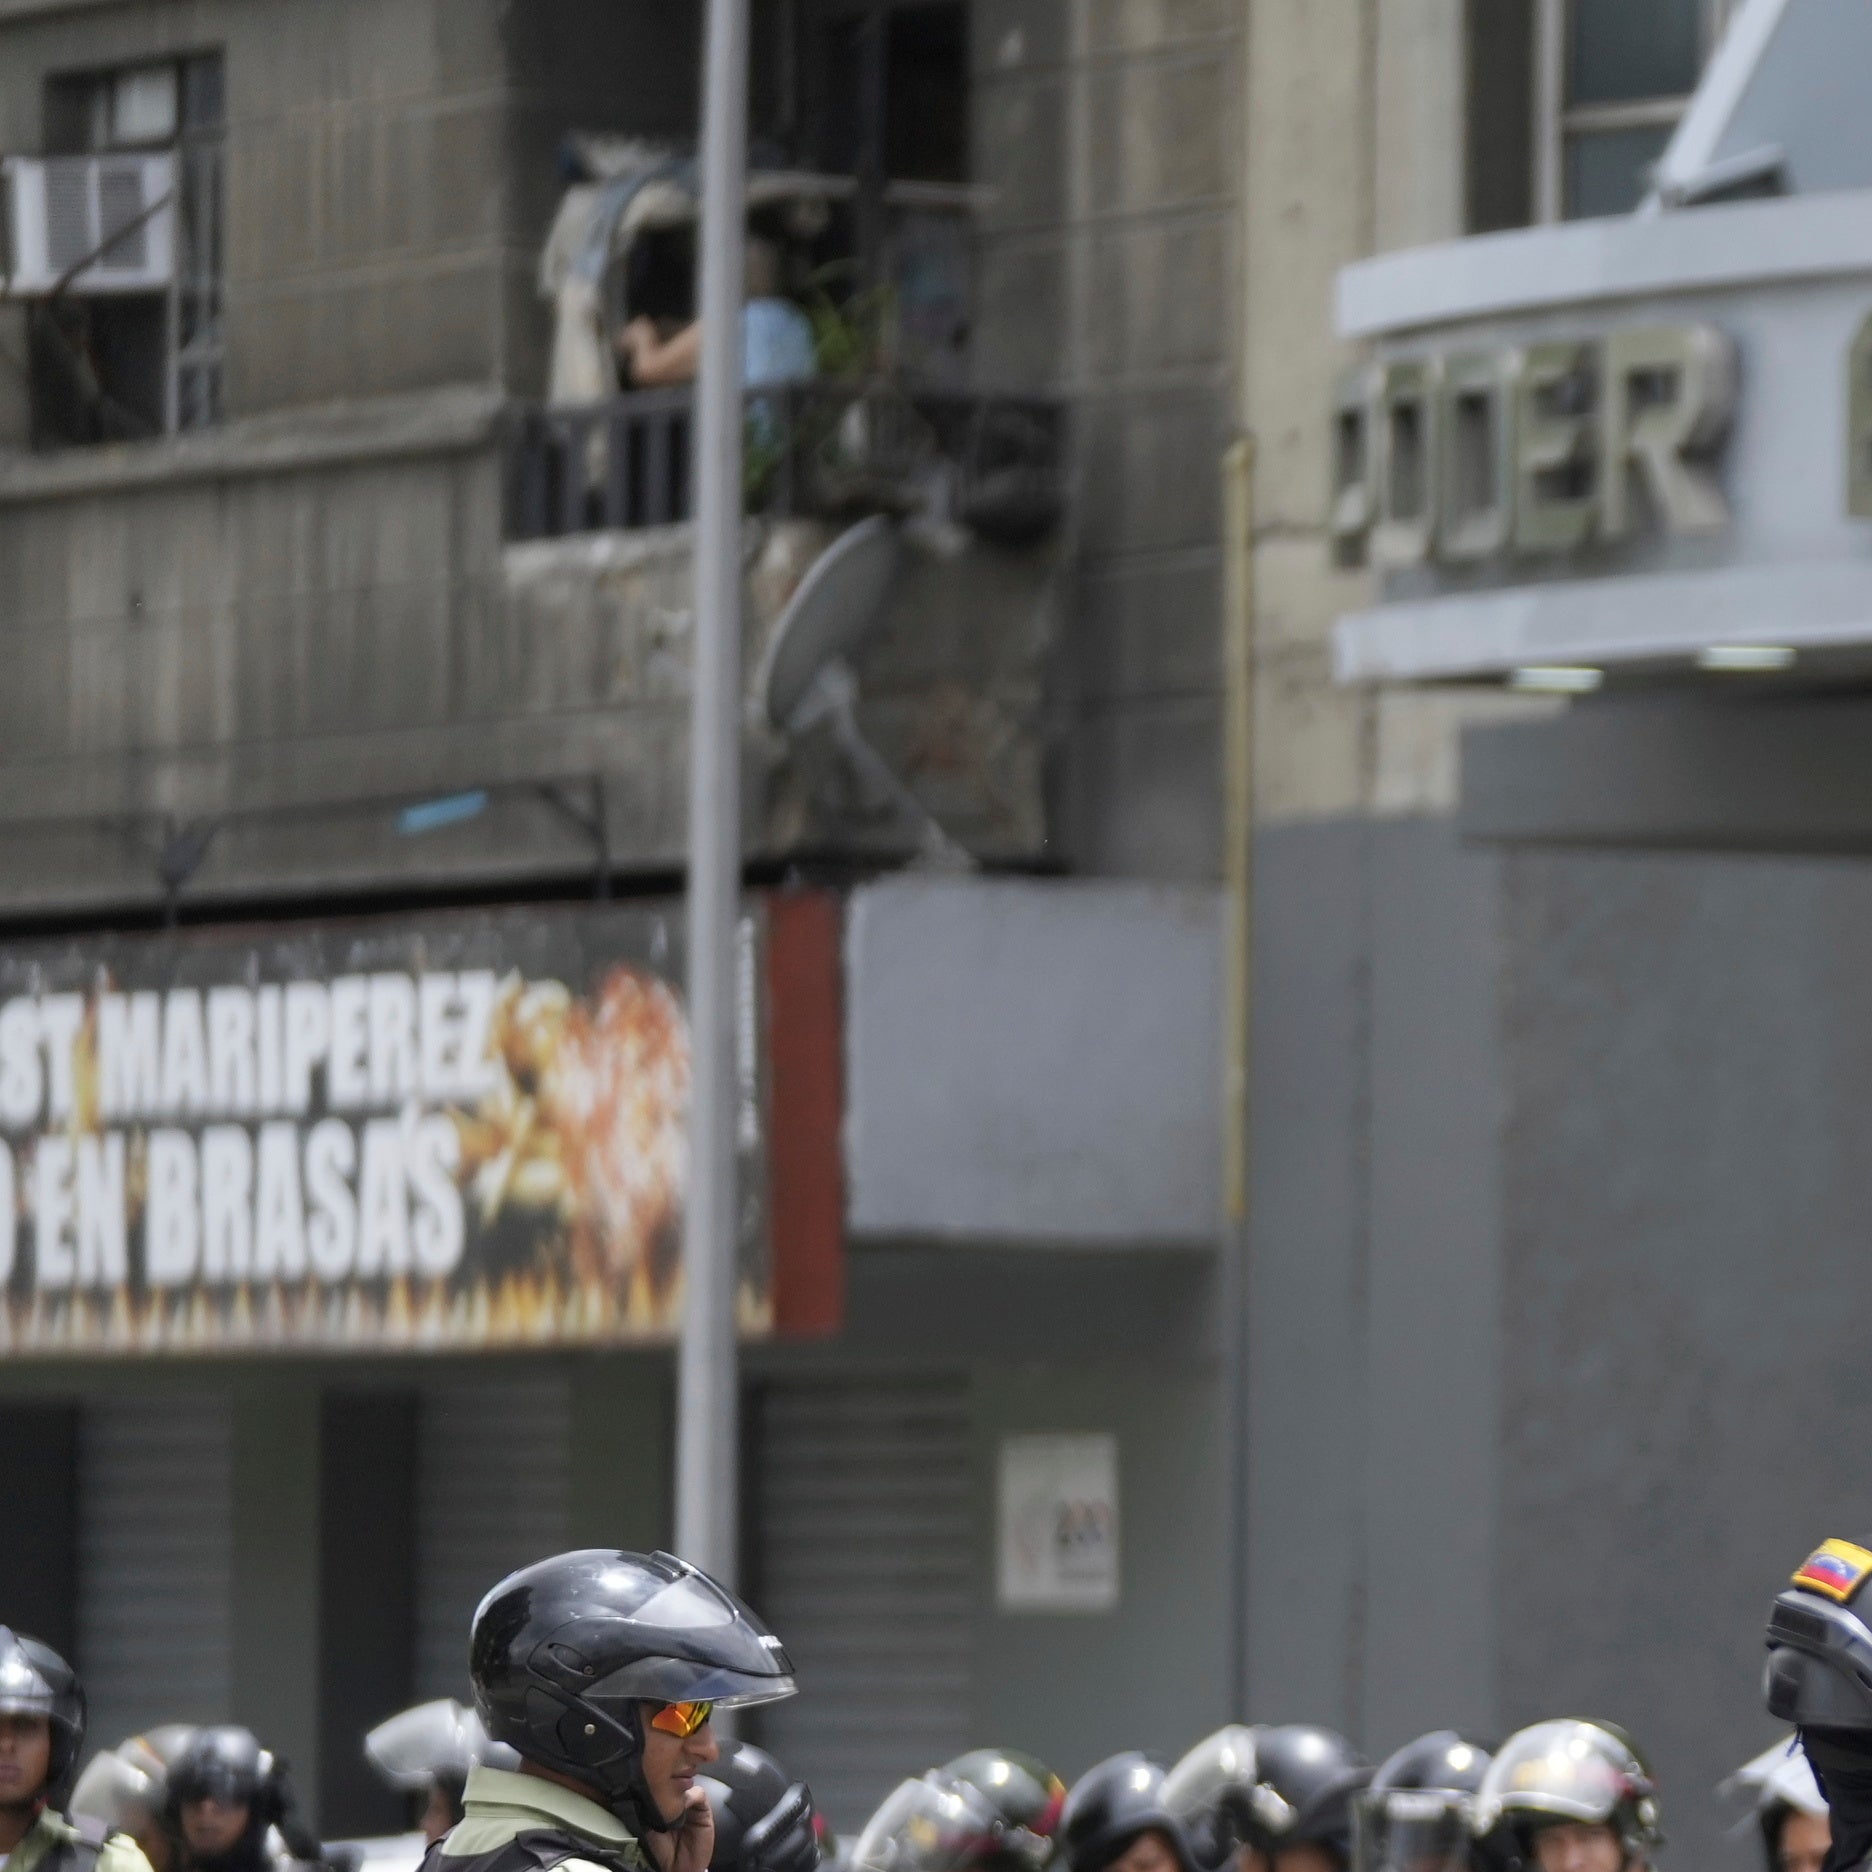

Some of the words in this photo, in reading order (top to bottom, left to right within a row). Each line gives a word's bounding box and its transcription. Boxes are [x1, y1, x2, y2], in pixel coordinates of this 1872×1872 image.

[97, 968, 498, 1122] MARIPEREZ
[36, 1131, 127, 1290] EN
[144, 1112, 465, 1287] BRASAS
